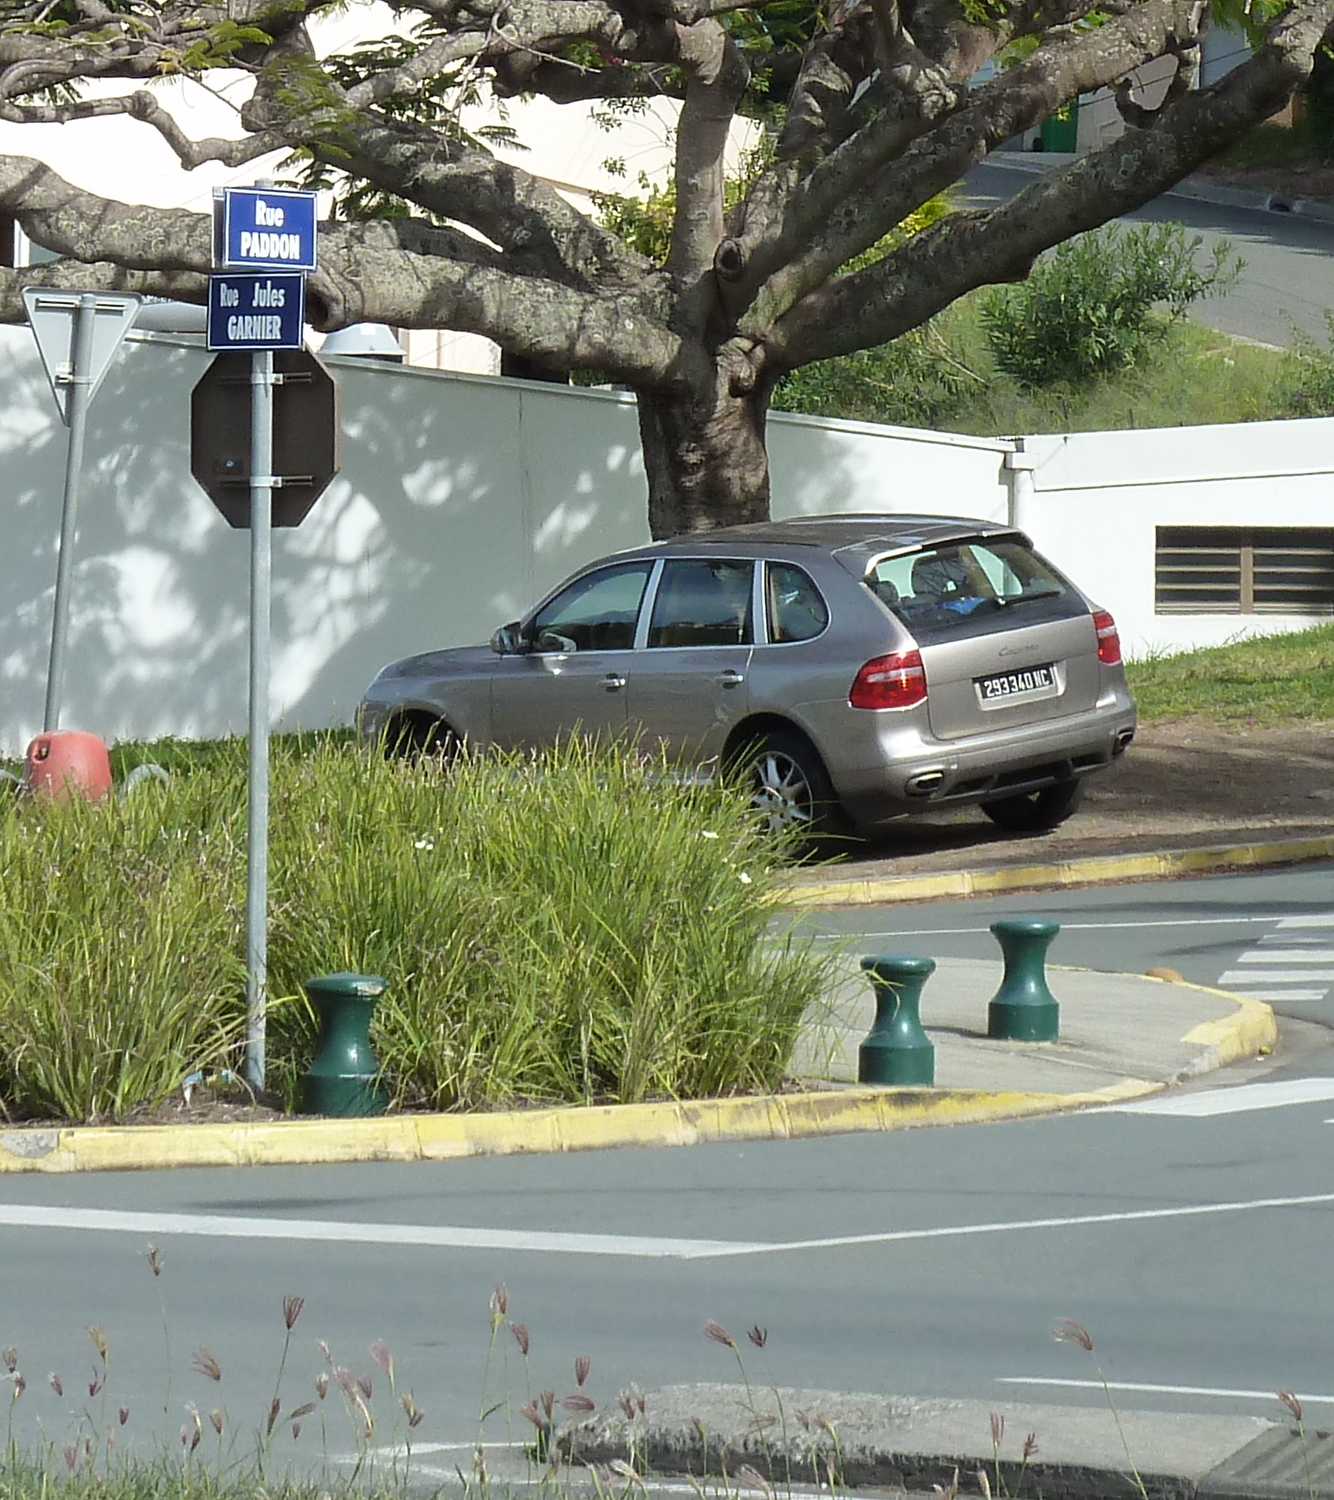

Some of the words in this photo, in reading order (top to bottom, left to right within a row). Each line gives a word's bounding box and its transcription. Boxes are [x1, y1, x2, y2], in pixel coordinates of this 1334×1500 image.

[255, 199, 284, 227] Rue
[240, 231, 301, 260] PADDON
[220, 283, 239, 307] Rue
[252, 280, 286, 307] Jules
[227, 315, 282, 340] GARNIER
